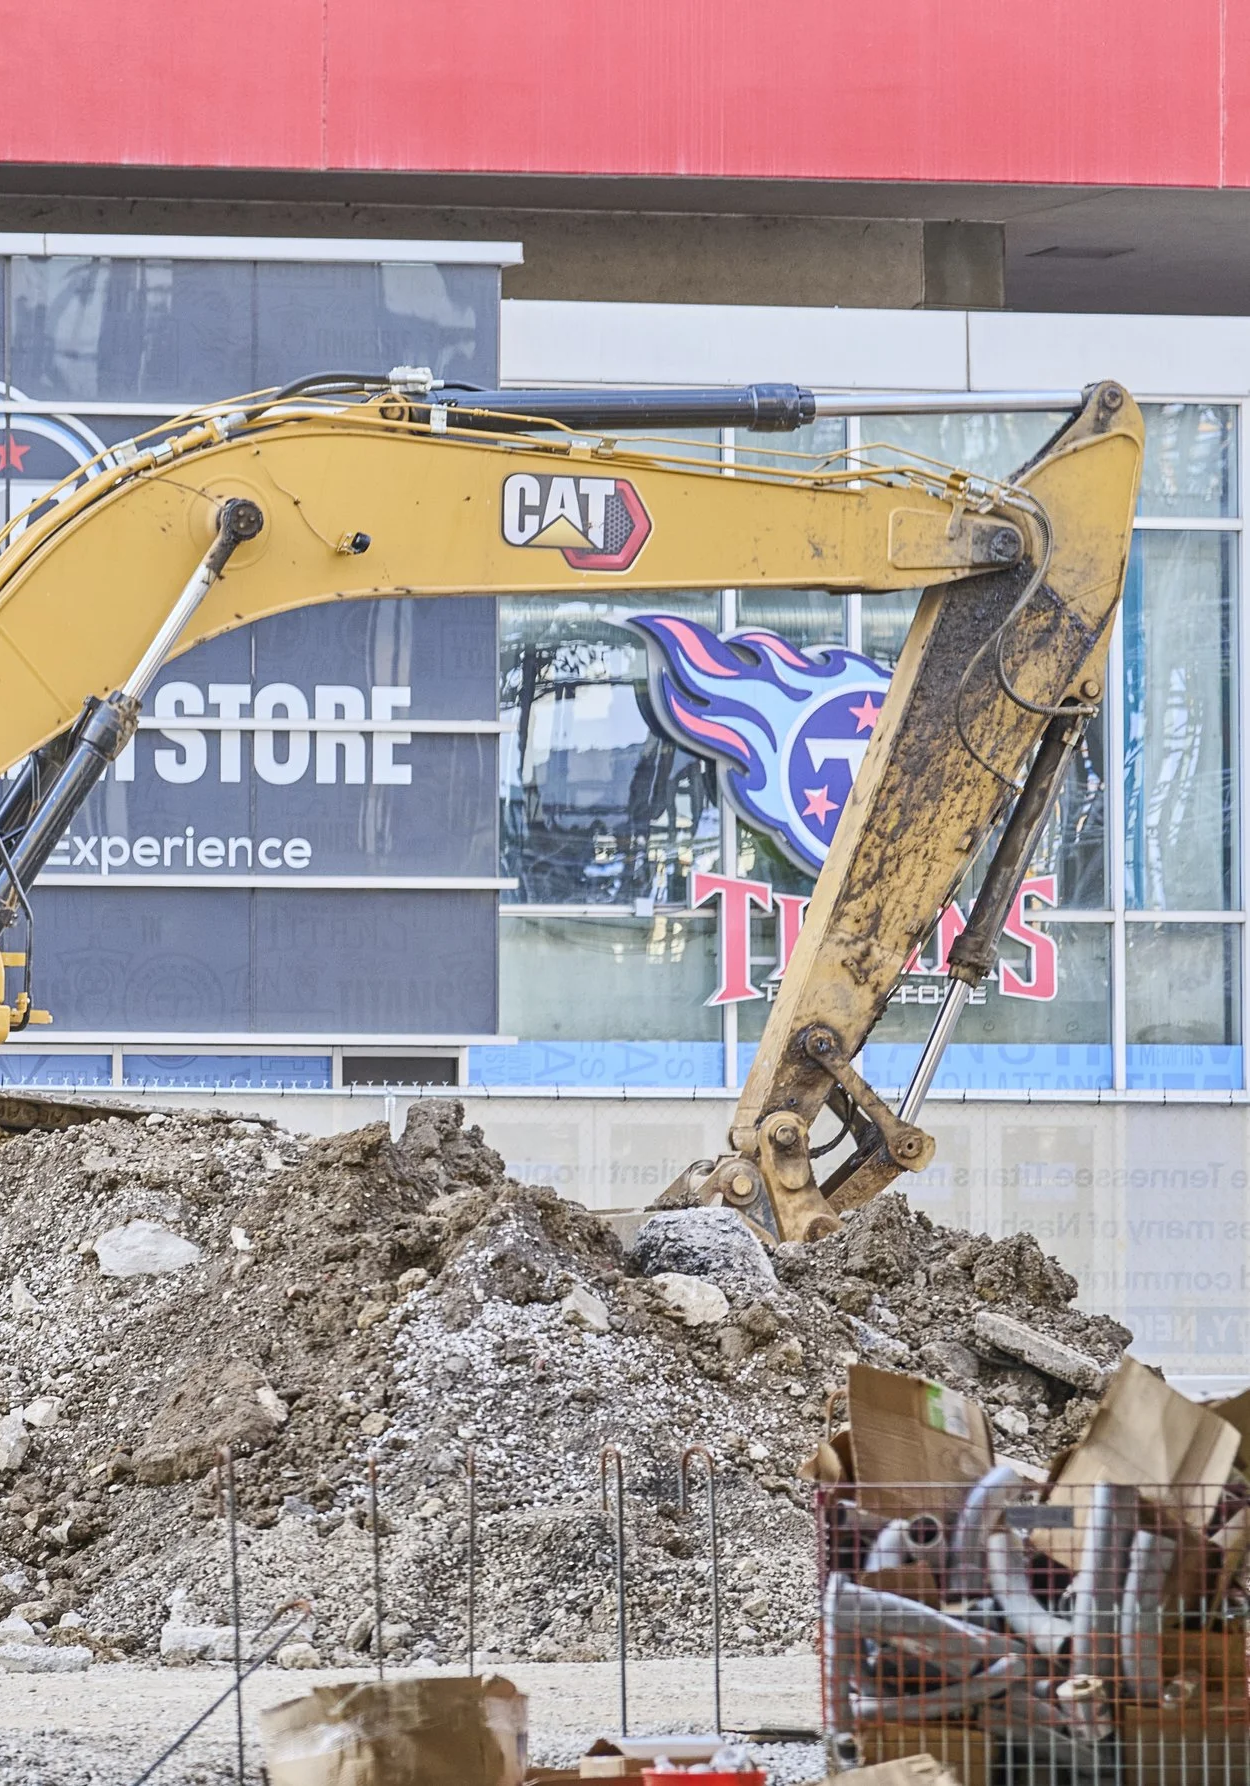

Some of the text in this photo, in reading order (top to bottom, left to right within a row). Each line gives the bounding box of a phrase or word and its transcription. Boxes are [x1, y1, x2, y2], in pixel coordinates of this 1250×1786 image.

[504, 473, 616, 549] CAT
[154, 681, 413, 785] STORE
[46, 826, 312, 876] Experience
